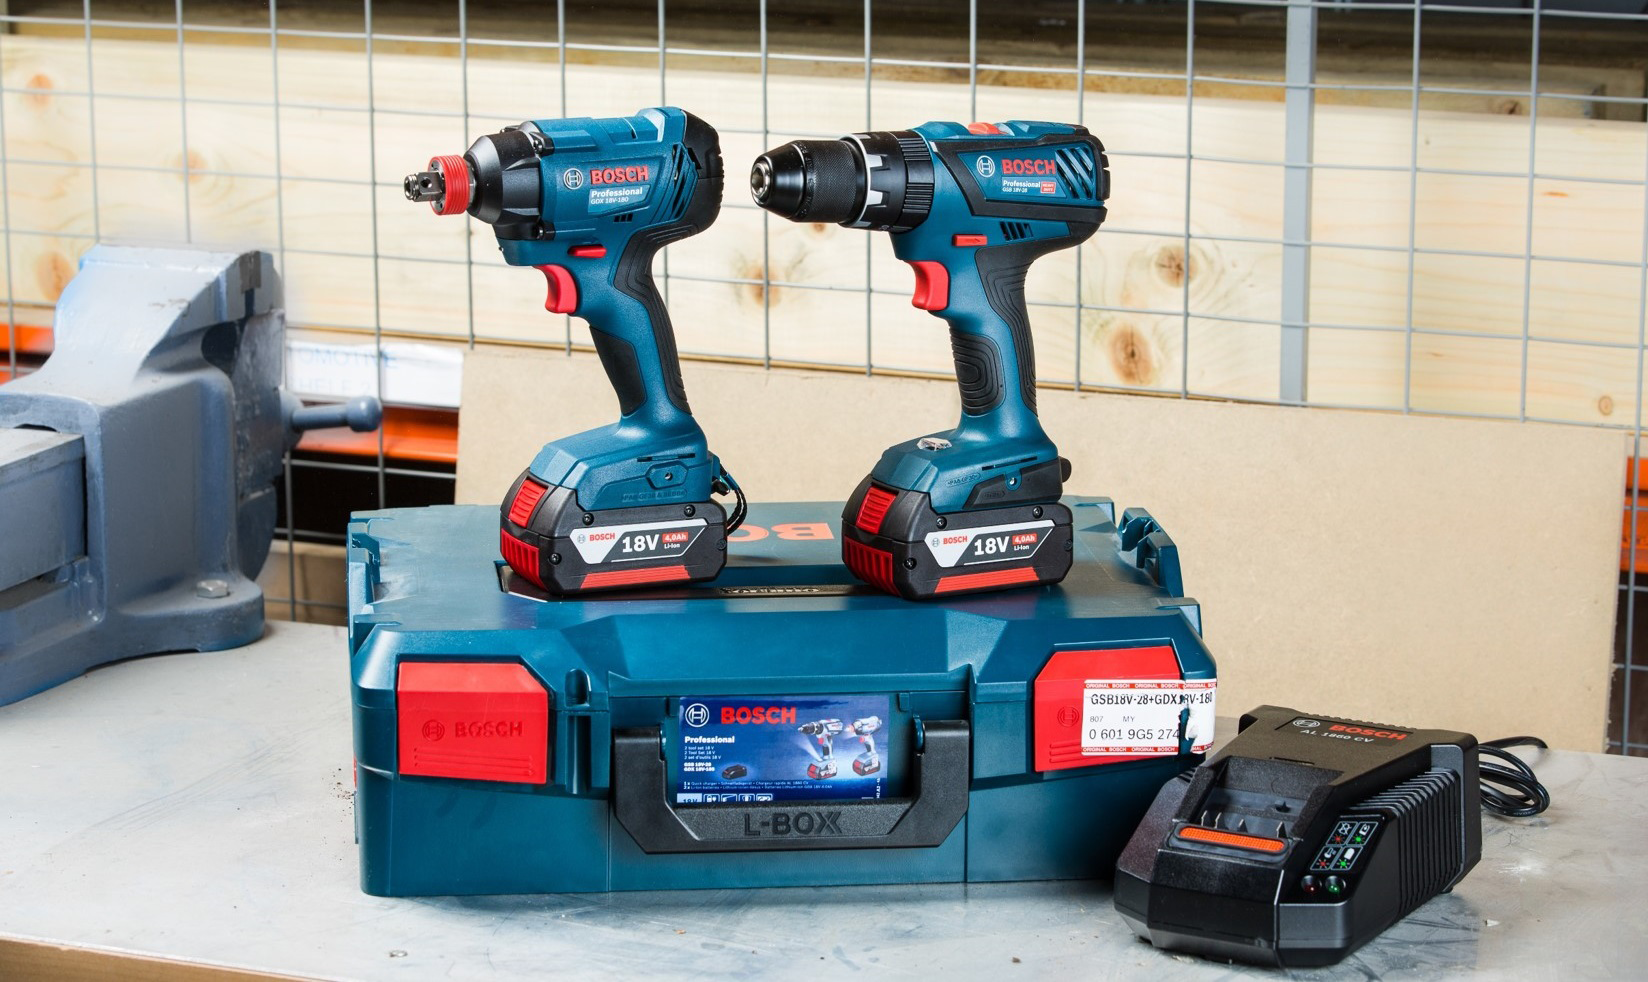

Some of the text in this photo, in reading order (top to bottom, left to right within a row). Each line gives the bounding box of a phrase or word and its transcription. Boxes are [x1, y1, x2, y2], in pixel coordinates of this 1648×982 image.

[590, 165, 648, 184] BOSCH
[1002, 159, 1056, 174] BOSCH
[591, 187, 642, 198] Professional
[590, 533, 686, 553] BOSCH 18V 4,0Ah
[943, 536, 1035, 556] BOSCH 18V 4,0Ah
[721, 706, 796, 724] BOSCH
[455, 721, 522, 738] BOSCH
[1089, 729, 1179, 740] 0 601 9G5 274
[1329, 725, 1407, 740] BOSCH
